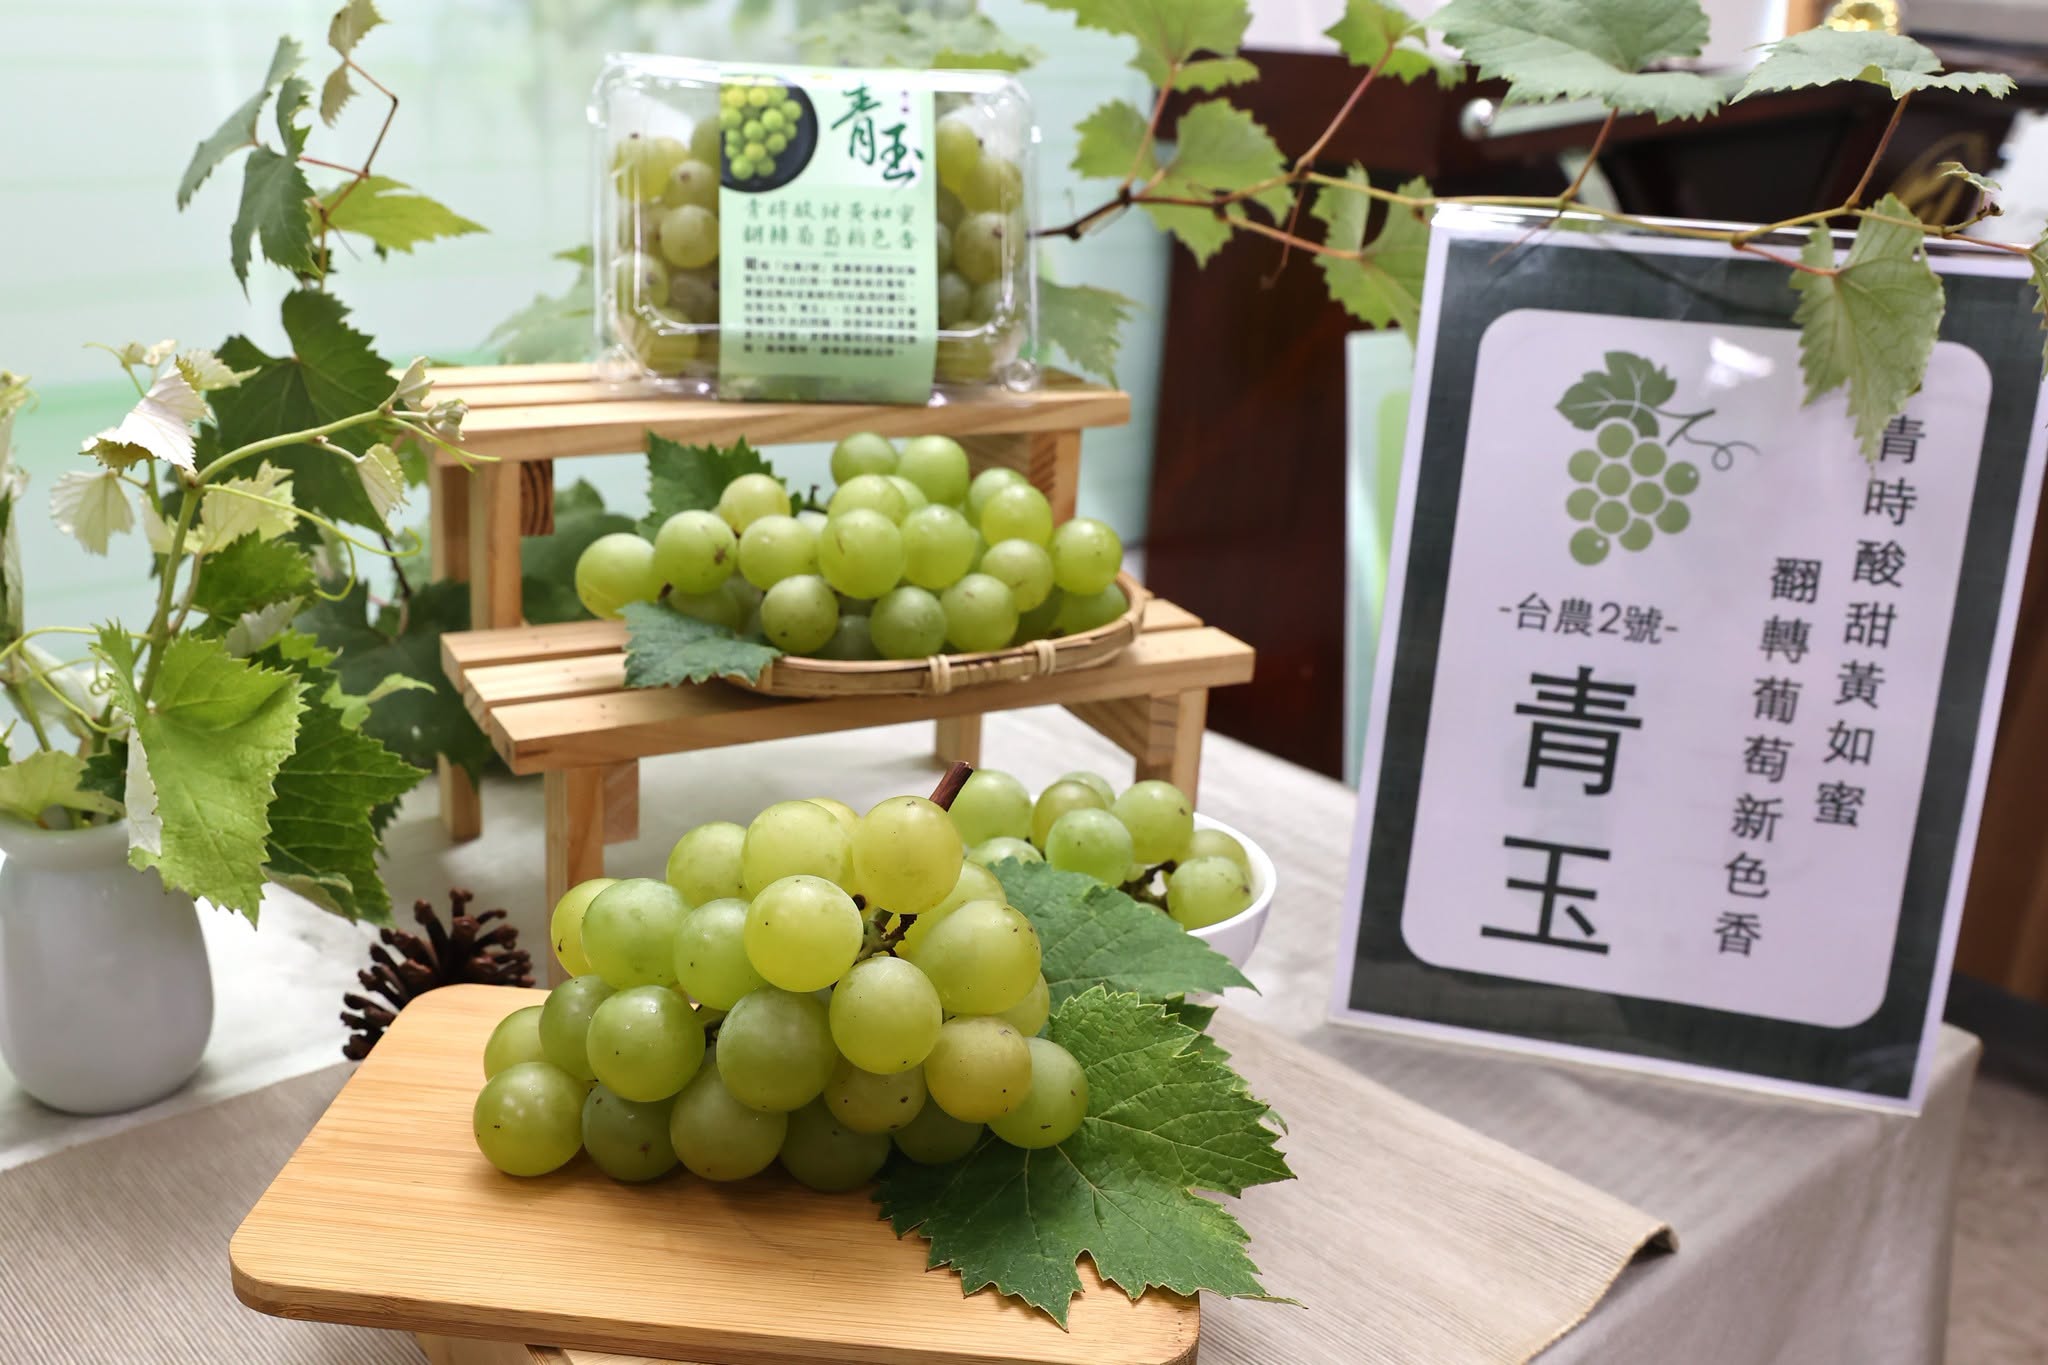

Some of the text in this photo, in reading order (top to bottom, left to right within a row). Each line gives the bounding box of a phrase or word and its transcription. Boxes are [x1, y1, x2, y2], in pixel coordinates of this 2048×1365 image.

[1480, 666, 1643, 956] 青玉
[1714, 557, 1822, 957] 翻轉葡萄新色香
[1814, 413, 1926, 828] 青時酸甜黃如蜜
